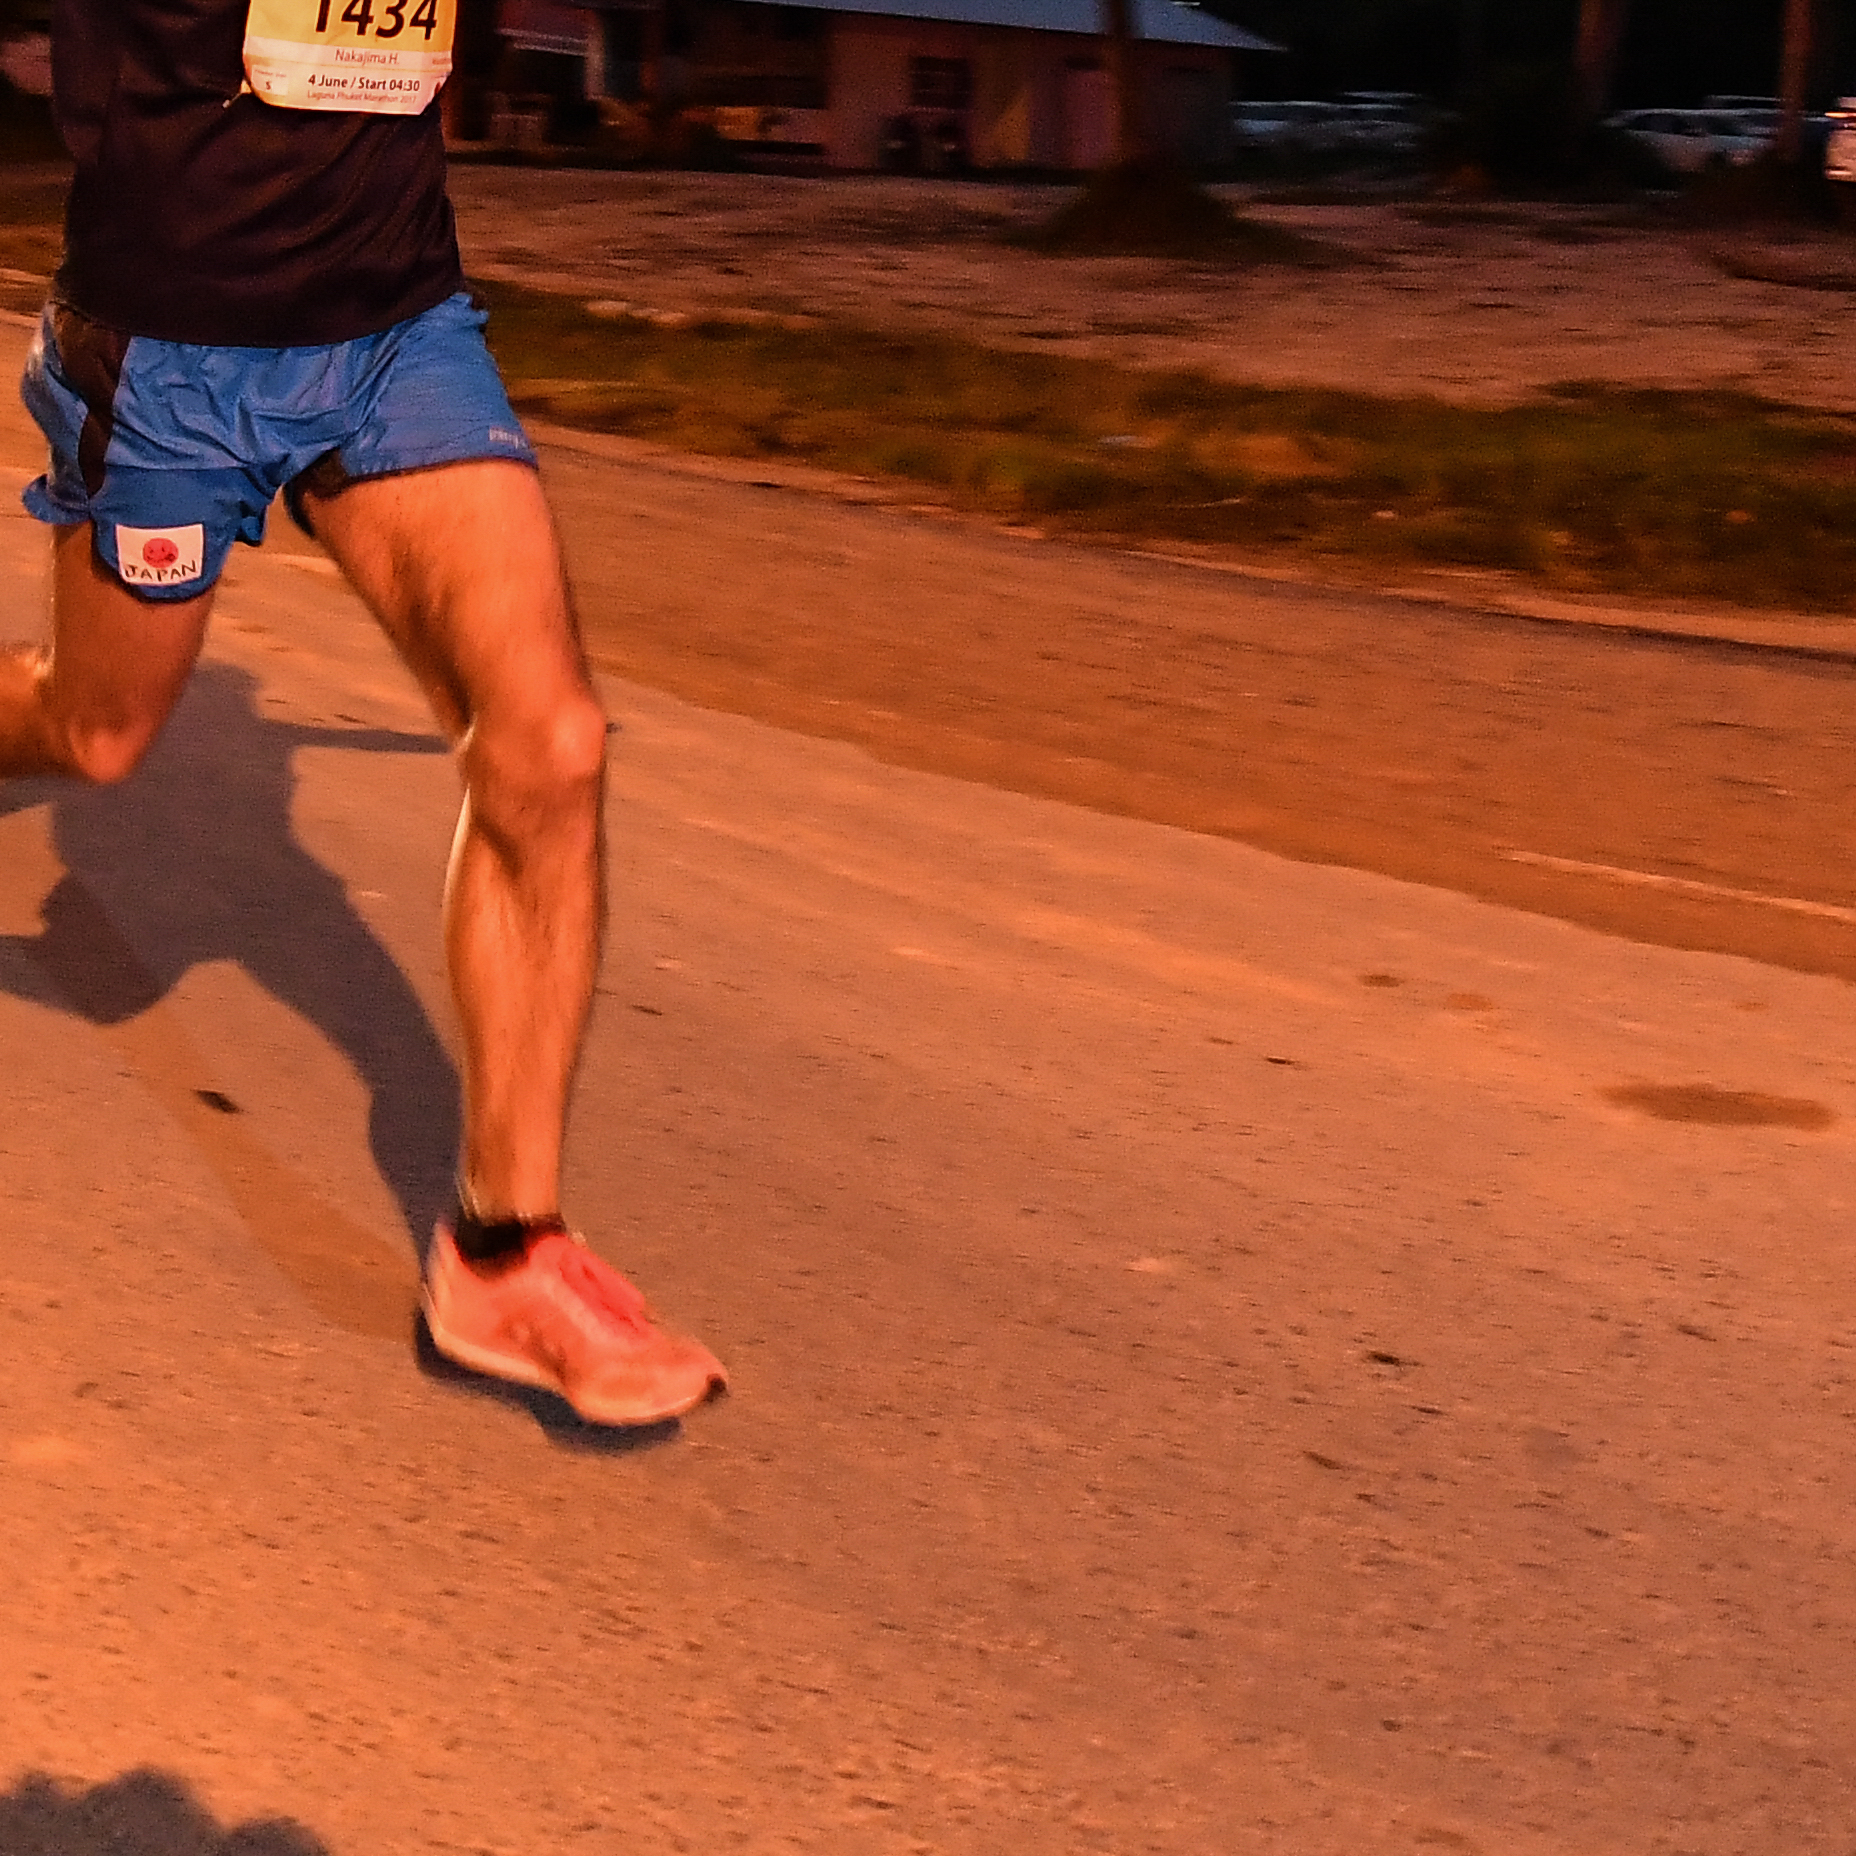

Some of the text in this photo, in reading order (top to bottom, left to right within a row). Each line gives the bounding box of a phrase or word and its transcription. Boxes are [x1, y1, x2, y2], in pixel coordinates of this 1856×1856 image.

[335, 48, 386, 67] Nakajima
[307, 73, 420, 92] 4 June / Start 04:30
[125, 560, 196, 582] JAPAN
